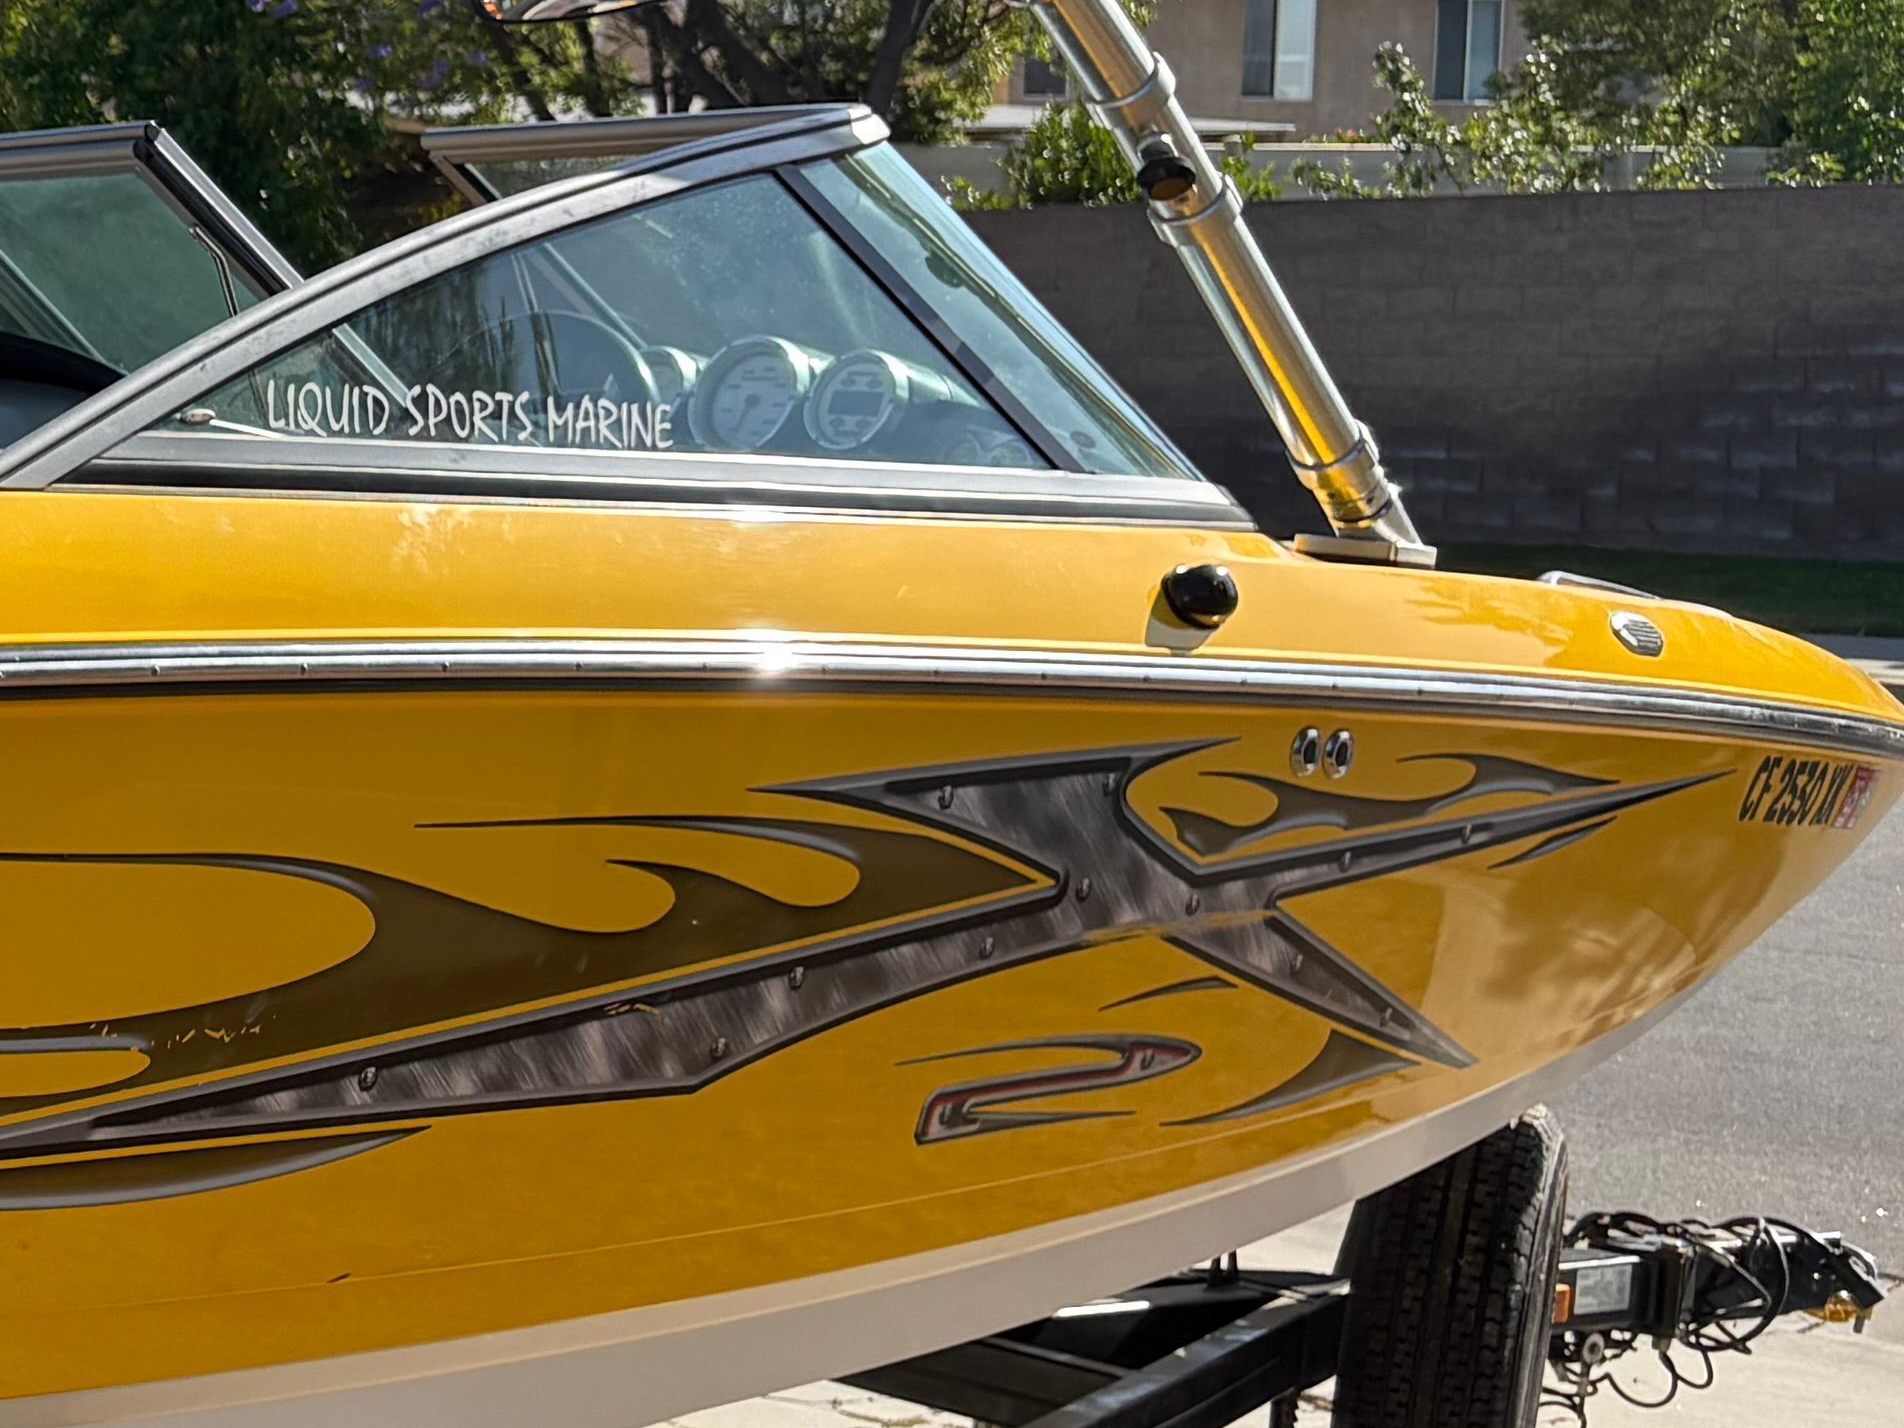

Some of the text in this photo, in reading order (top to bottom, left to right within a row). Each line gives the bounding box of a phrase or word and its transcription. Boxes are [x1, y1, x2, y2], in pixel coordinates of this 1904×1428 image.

[265, 380, 674, 449] LIQUID SPORTS MARINE
[1739, 755, 1783, 821] CF
